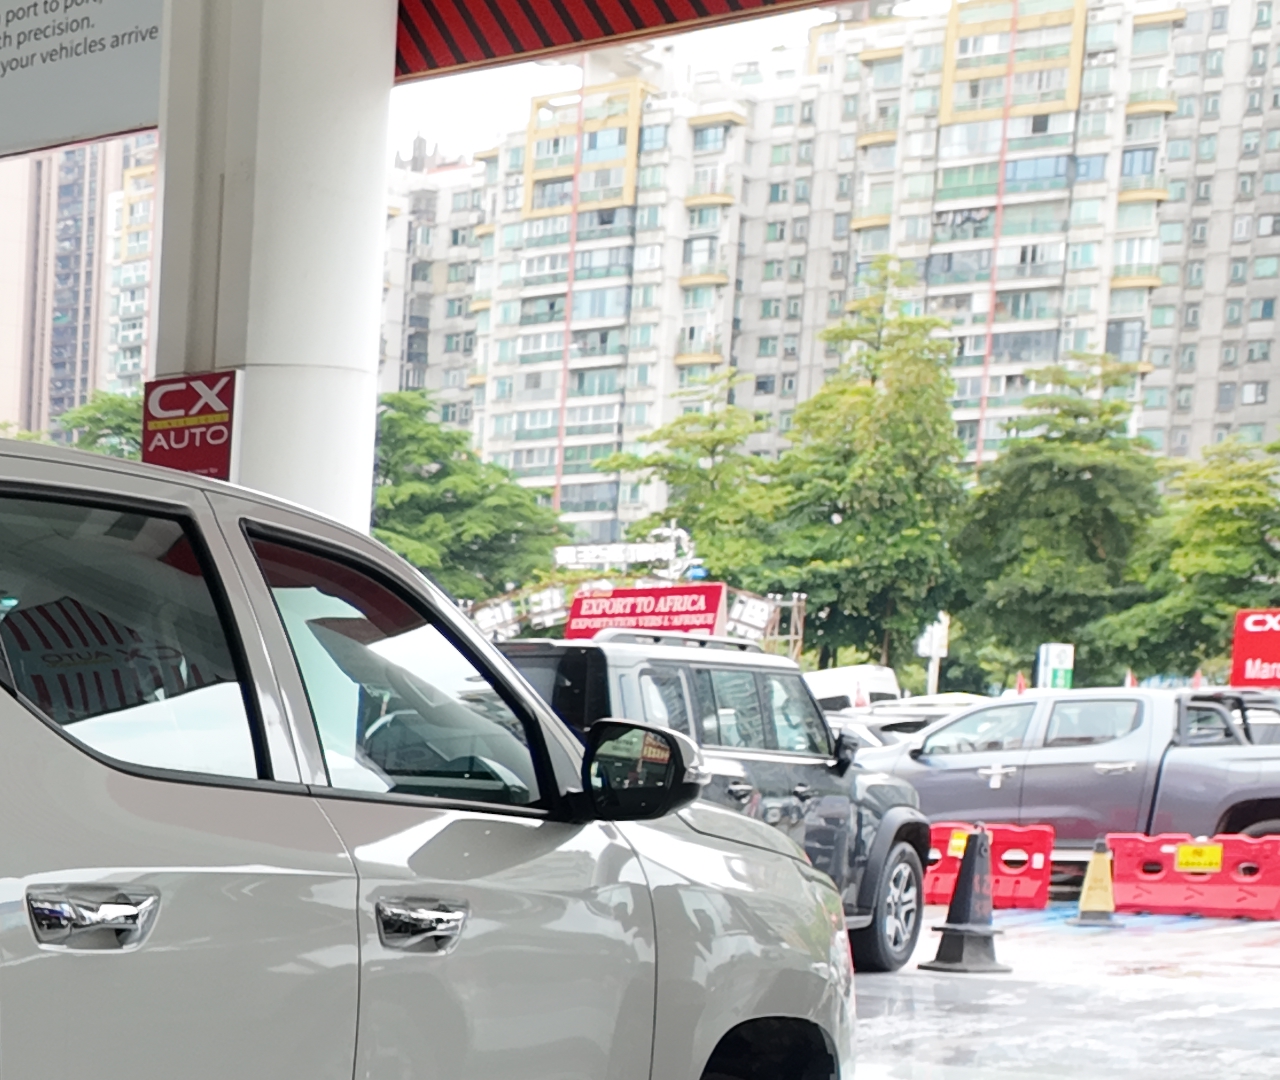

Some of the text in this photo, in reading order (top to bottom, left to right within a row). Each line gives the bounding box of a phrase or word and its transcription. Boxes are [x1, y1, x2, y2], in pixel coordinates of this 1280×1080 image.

[5, 2, 39, 27] port
[43, 0, 59, 14] to
[16, 15, 95, 50] precision.
[0, 52, 37, 78] your
[40, 37, 107, 64] vehicles
[109, 23, 159, 50] arrive
[148, 376, 230, 418] CX
[148, 425, 228, 452] AUTO
[580, 597, 636, 616] EXPORT
[637, 597, 654, 613] TO
[655, 594, 706, 613] AFRICA
[1243, 613, 1280, 632] CX
